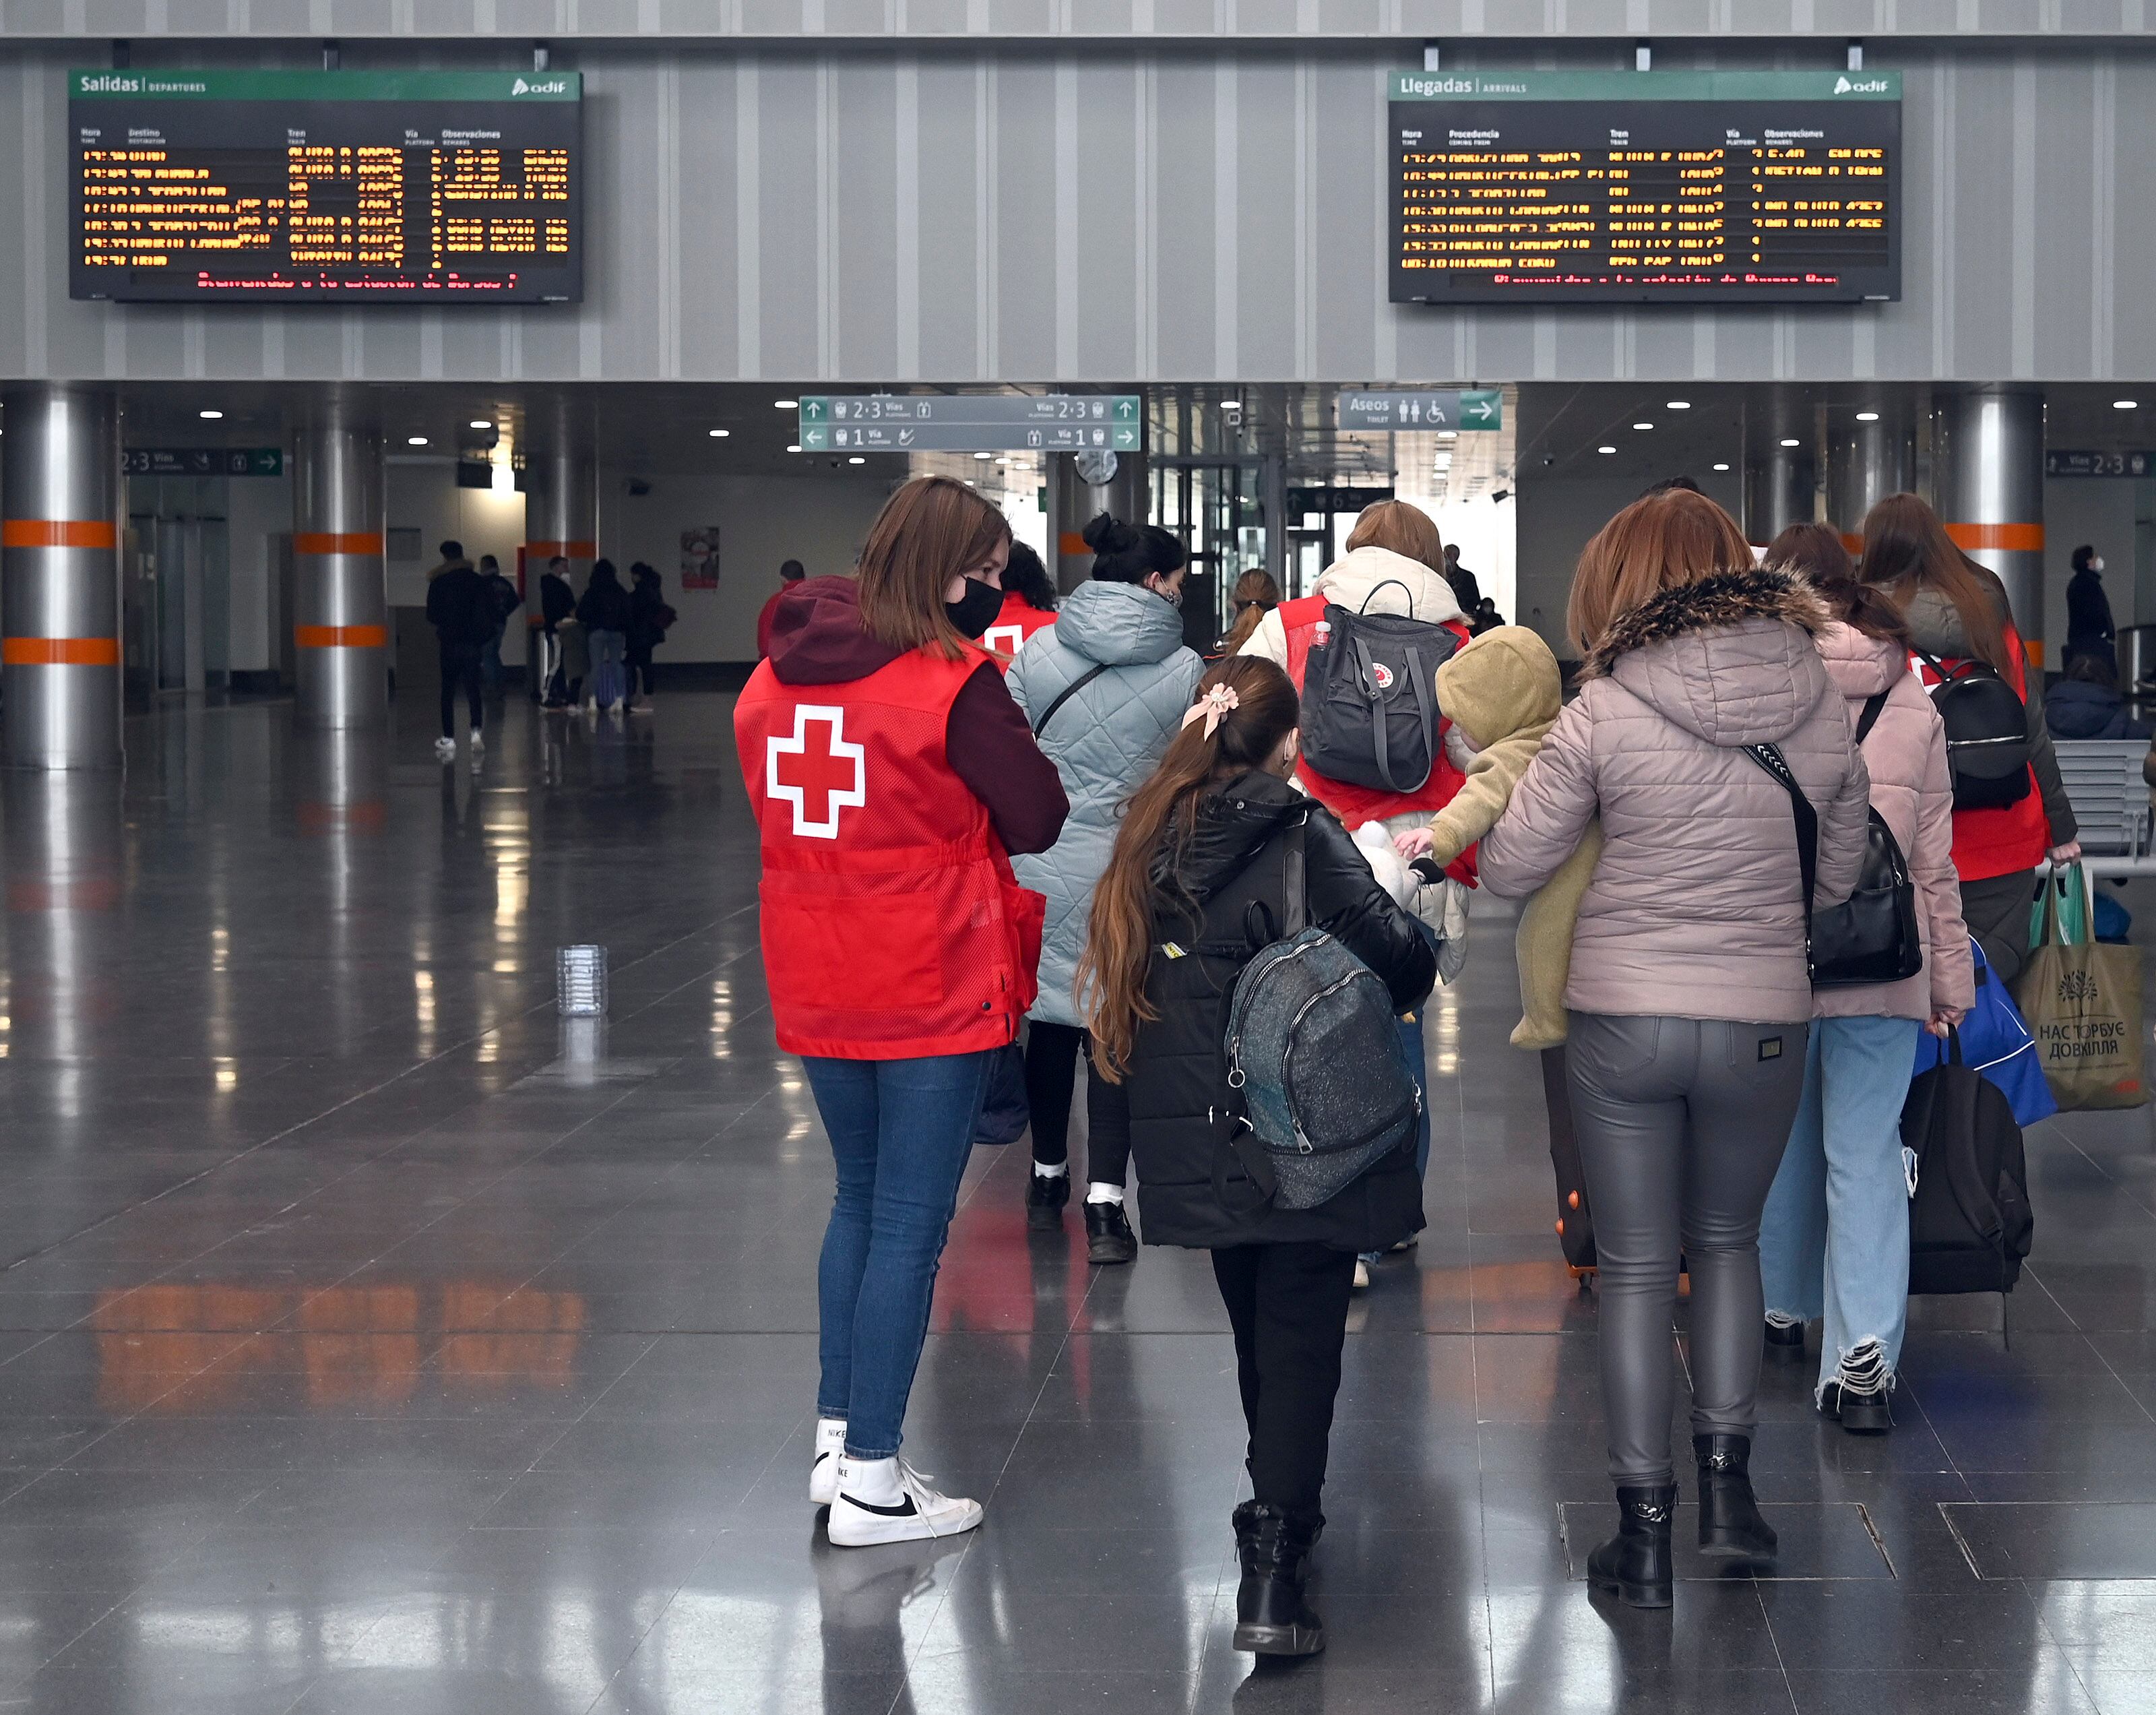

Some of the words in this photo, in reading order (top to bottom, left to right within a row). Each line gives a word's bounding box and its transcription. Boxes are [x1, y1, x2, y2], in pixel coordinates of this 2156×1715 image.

[81, 75, 139, 92] Salidas
[148, 83, 206, 92] DEPARTURES
[530, 82, 566, 93] adif
[1401, 77, 1472, 96] Llegadas
[1483, 84, 1527, 93] ARRIVALS
[1852, 81, 1888, 92] adif
[1350, 398, 1389, 412] Aseos
[854, 429, 864, 445] 1
[1075, 429, 1086, 445] 1
[2039, 1024, 2071, 1040] НАС
[2050, 1040, 2118, 1060] ДОВКІЛЛЯ
[828, 1429, 846, 1438] NIKE
